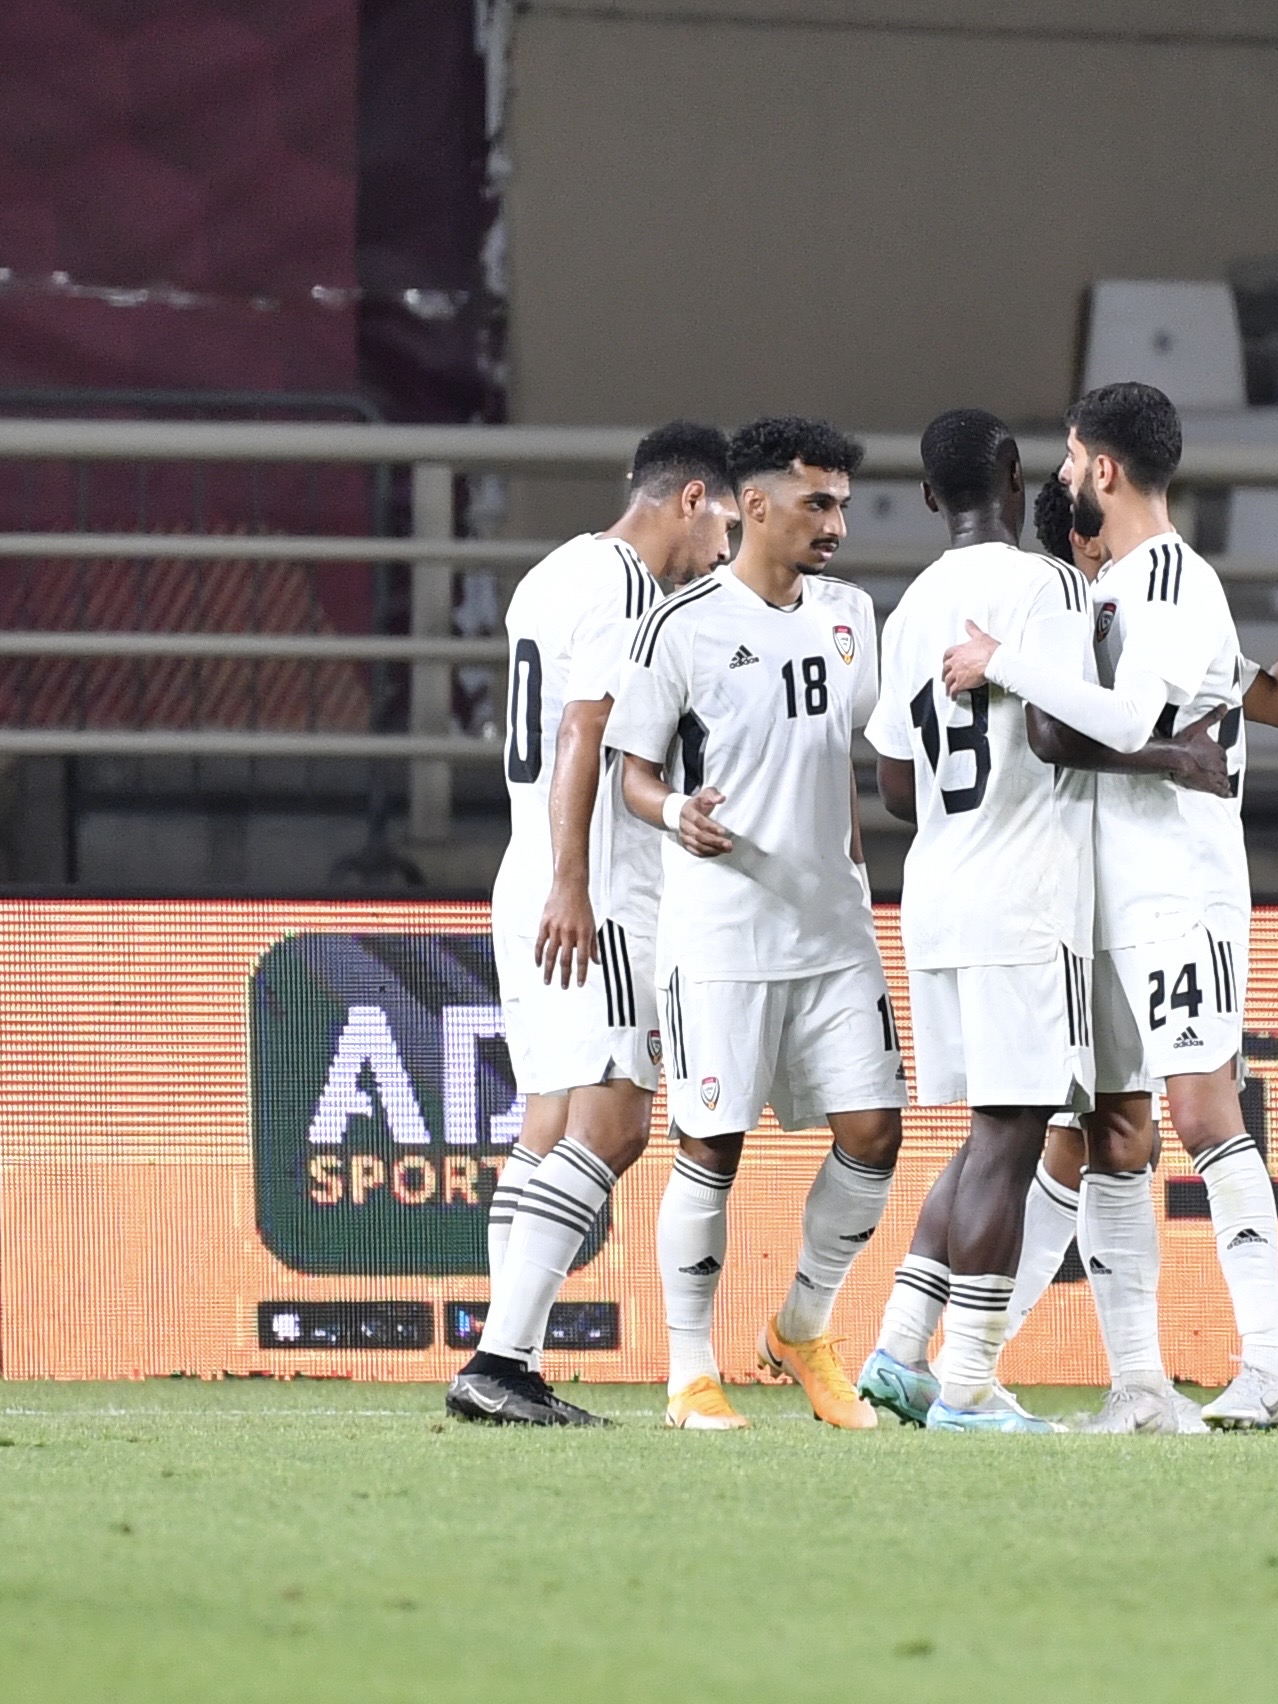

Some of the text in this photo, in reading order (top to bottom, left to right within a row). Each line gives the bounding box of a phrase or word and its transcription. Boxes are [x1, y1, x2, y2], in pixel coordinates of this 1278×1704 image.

[781, 655, 829, 719] 18
[909, 677, 992, 816] 13
[877, 993, 901, 1051] 1
[1148, 962, 1204, 1032] 24
[1173, 1038, 1205, 1049] adidas
